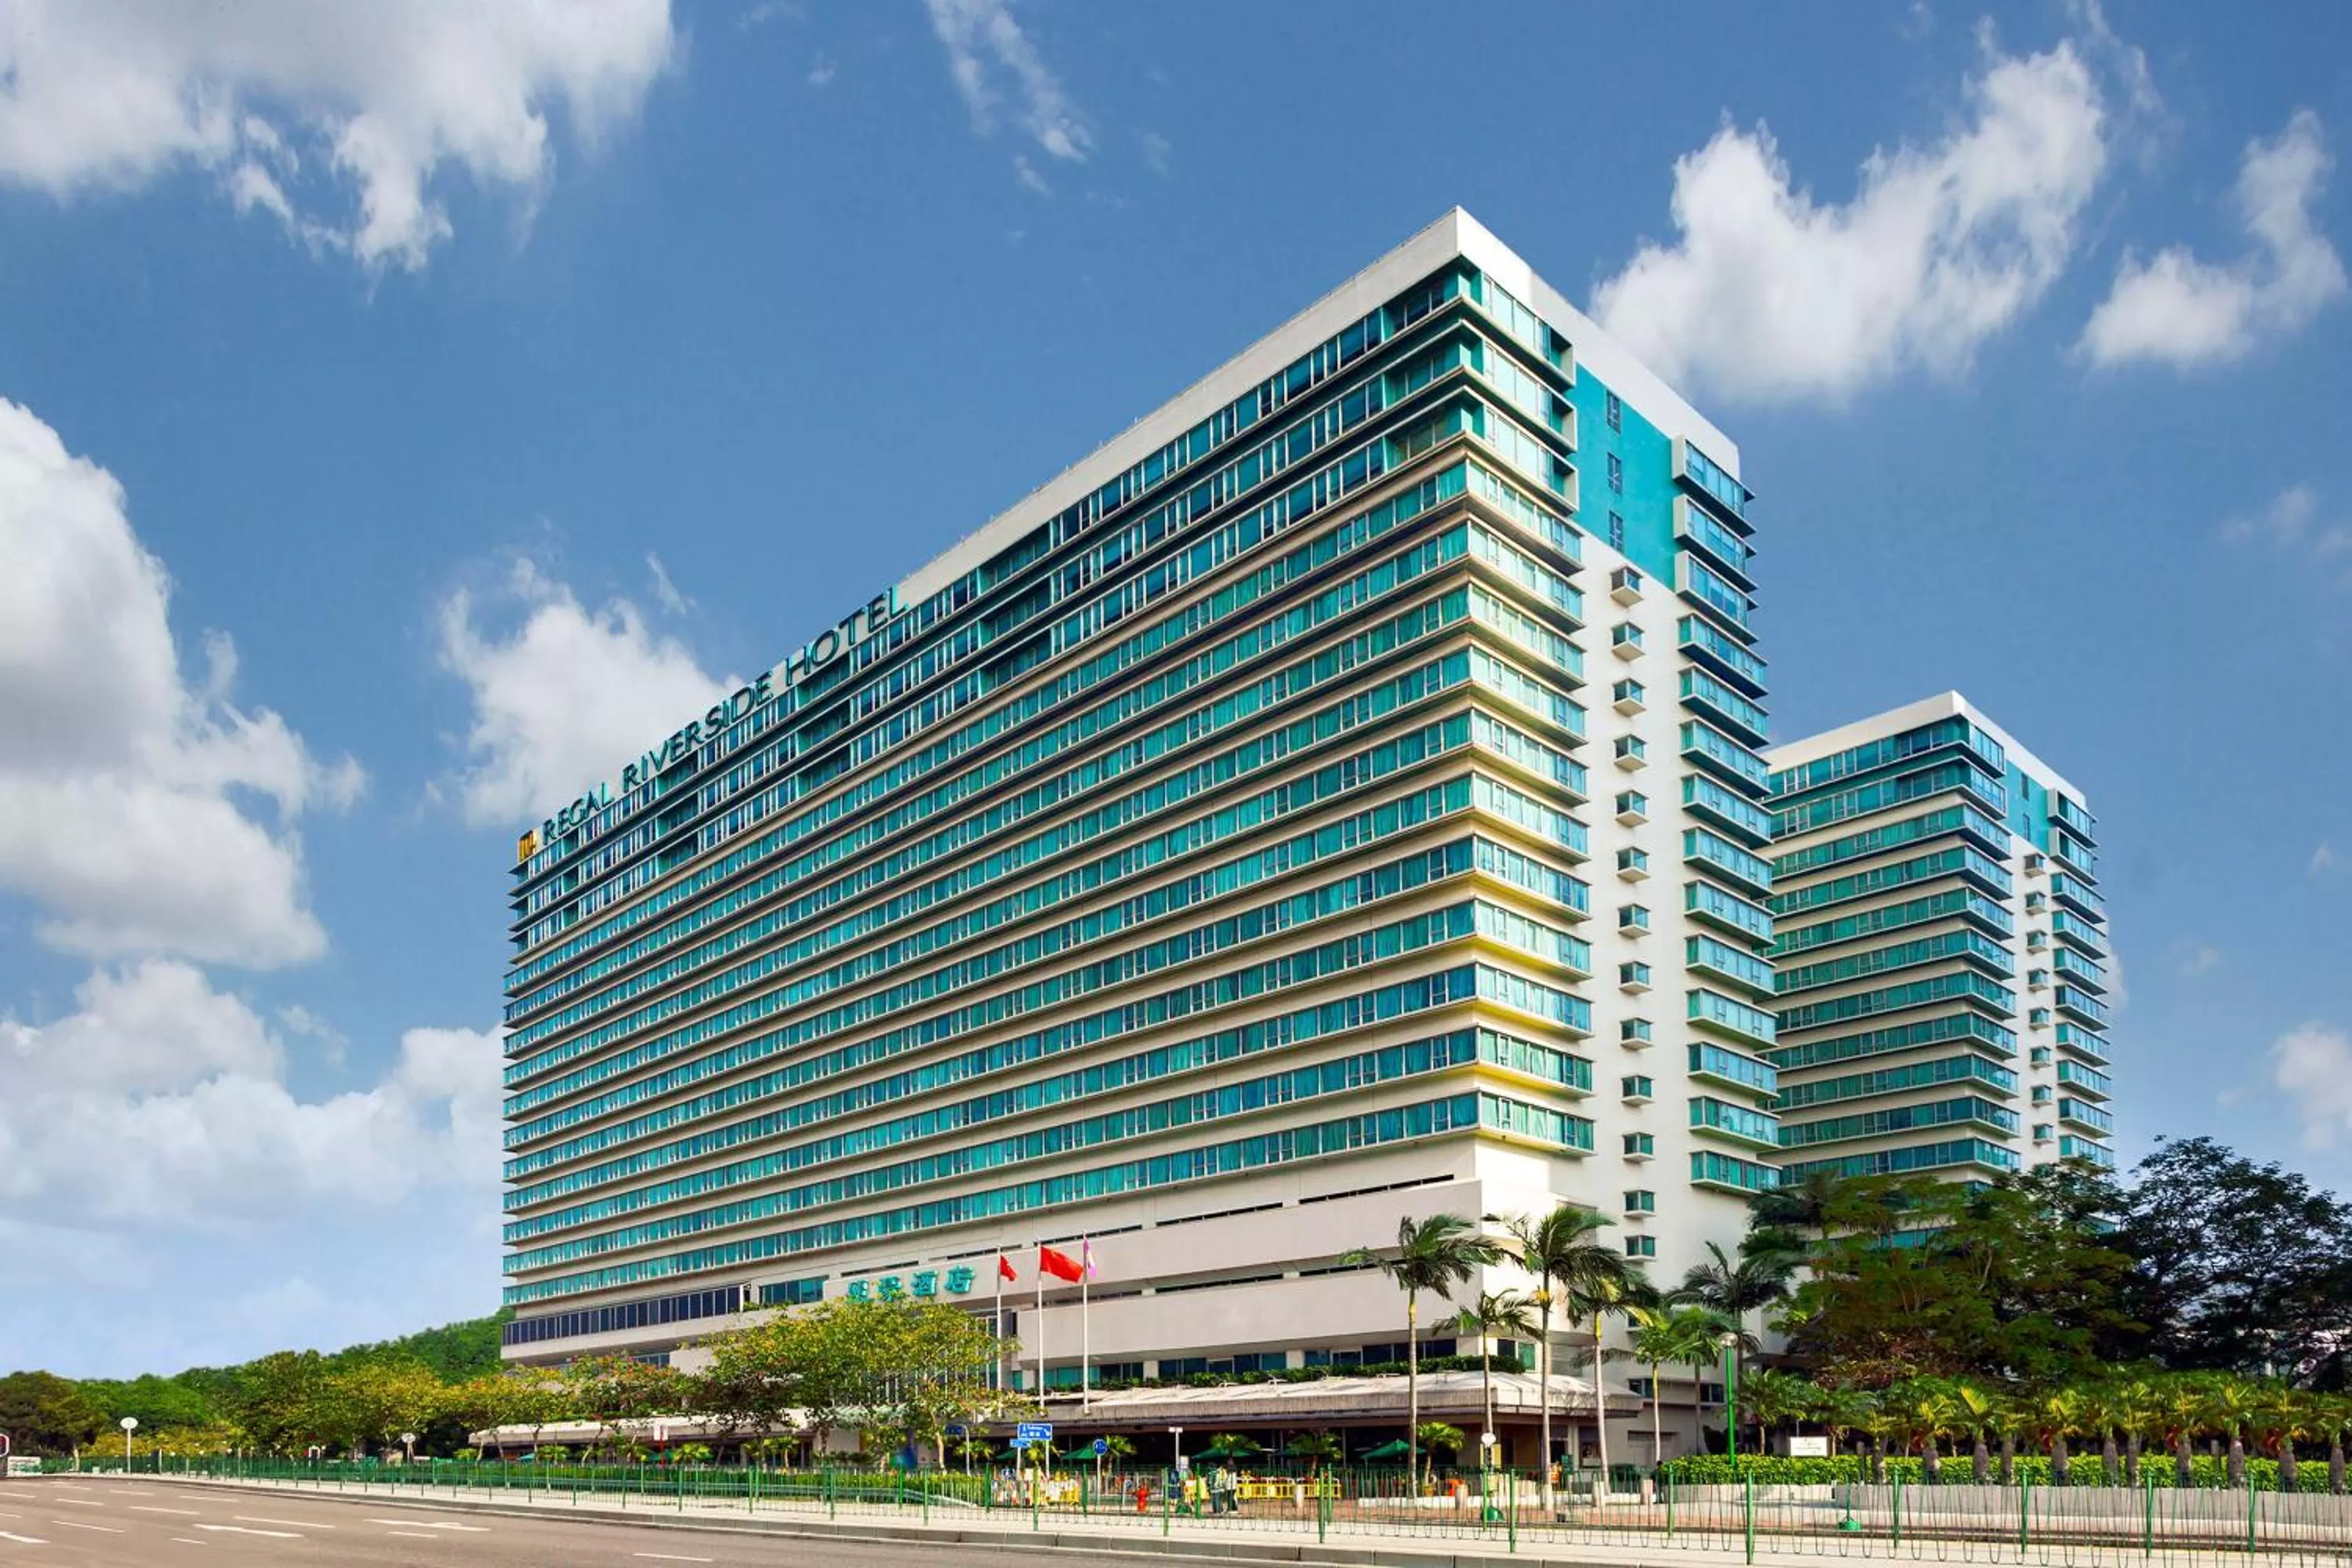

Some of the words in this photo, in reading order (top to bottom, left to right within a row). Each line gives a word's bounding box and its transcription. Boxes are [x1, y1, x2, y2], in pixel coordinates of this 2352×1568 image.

[542, 782, 615, 845] REGAL
[622, 670, 774, 793] RIVERSIDE
[786, 585, 909, 687] HOTEL
